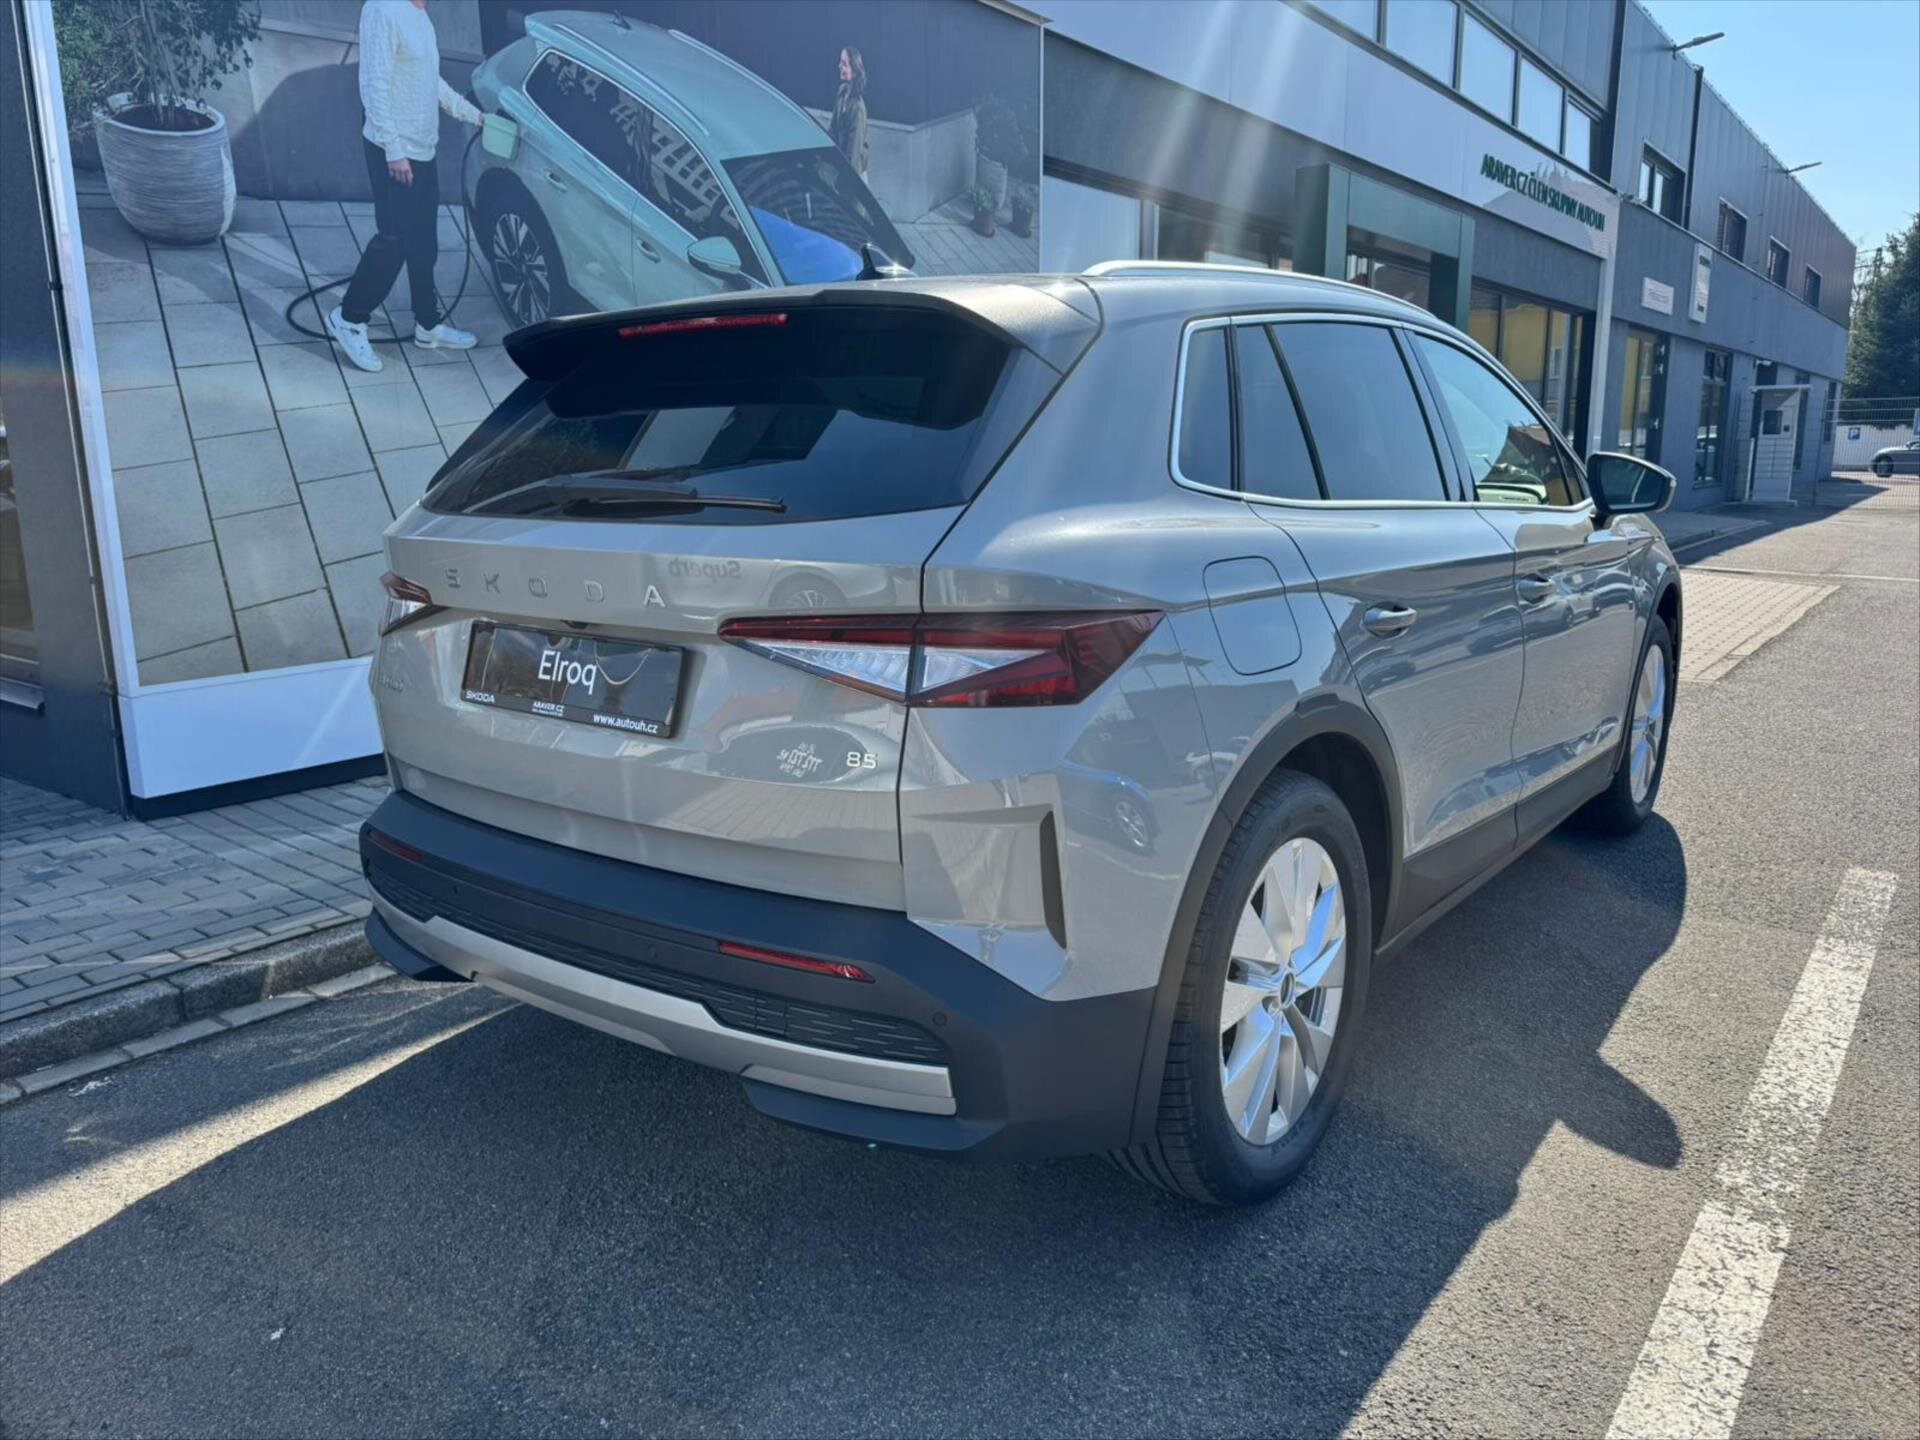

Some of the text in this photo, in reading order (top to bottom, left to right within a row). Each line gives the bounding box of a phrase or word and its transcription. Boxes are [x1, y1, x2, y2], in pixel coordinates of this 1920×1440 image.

[1480, 153, 1517, 190] ARAVER
[537, 650, 597, 695] Elroq
[593, 713, 658, 734] www.autouh.cz
[846, 751, 877, 769] 85
